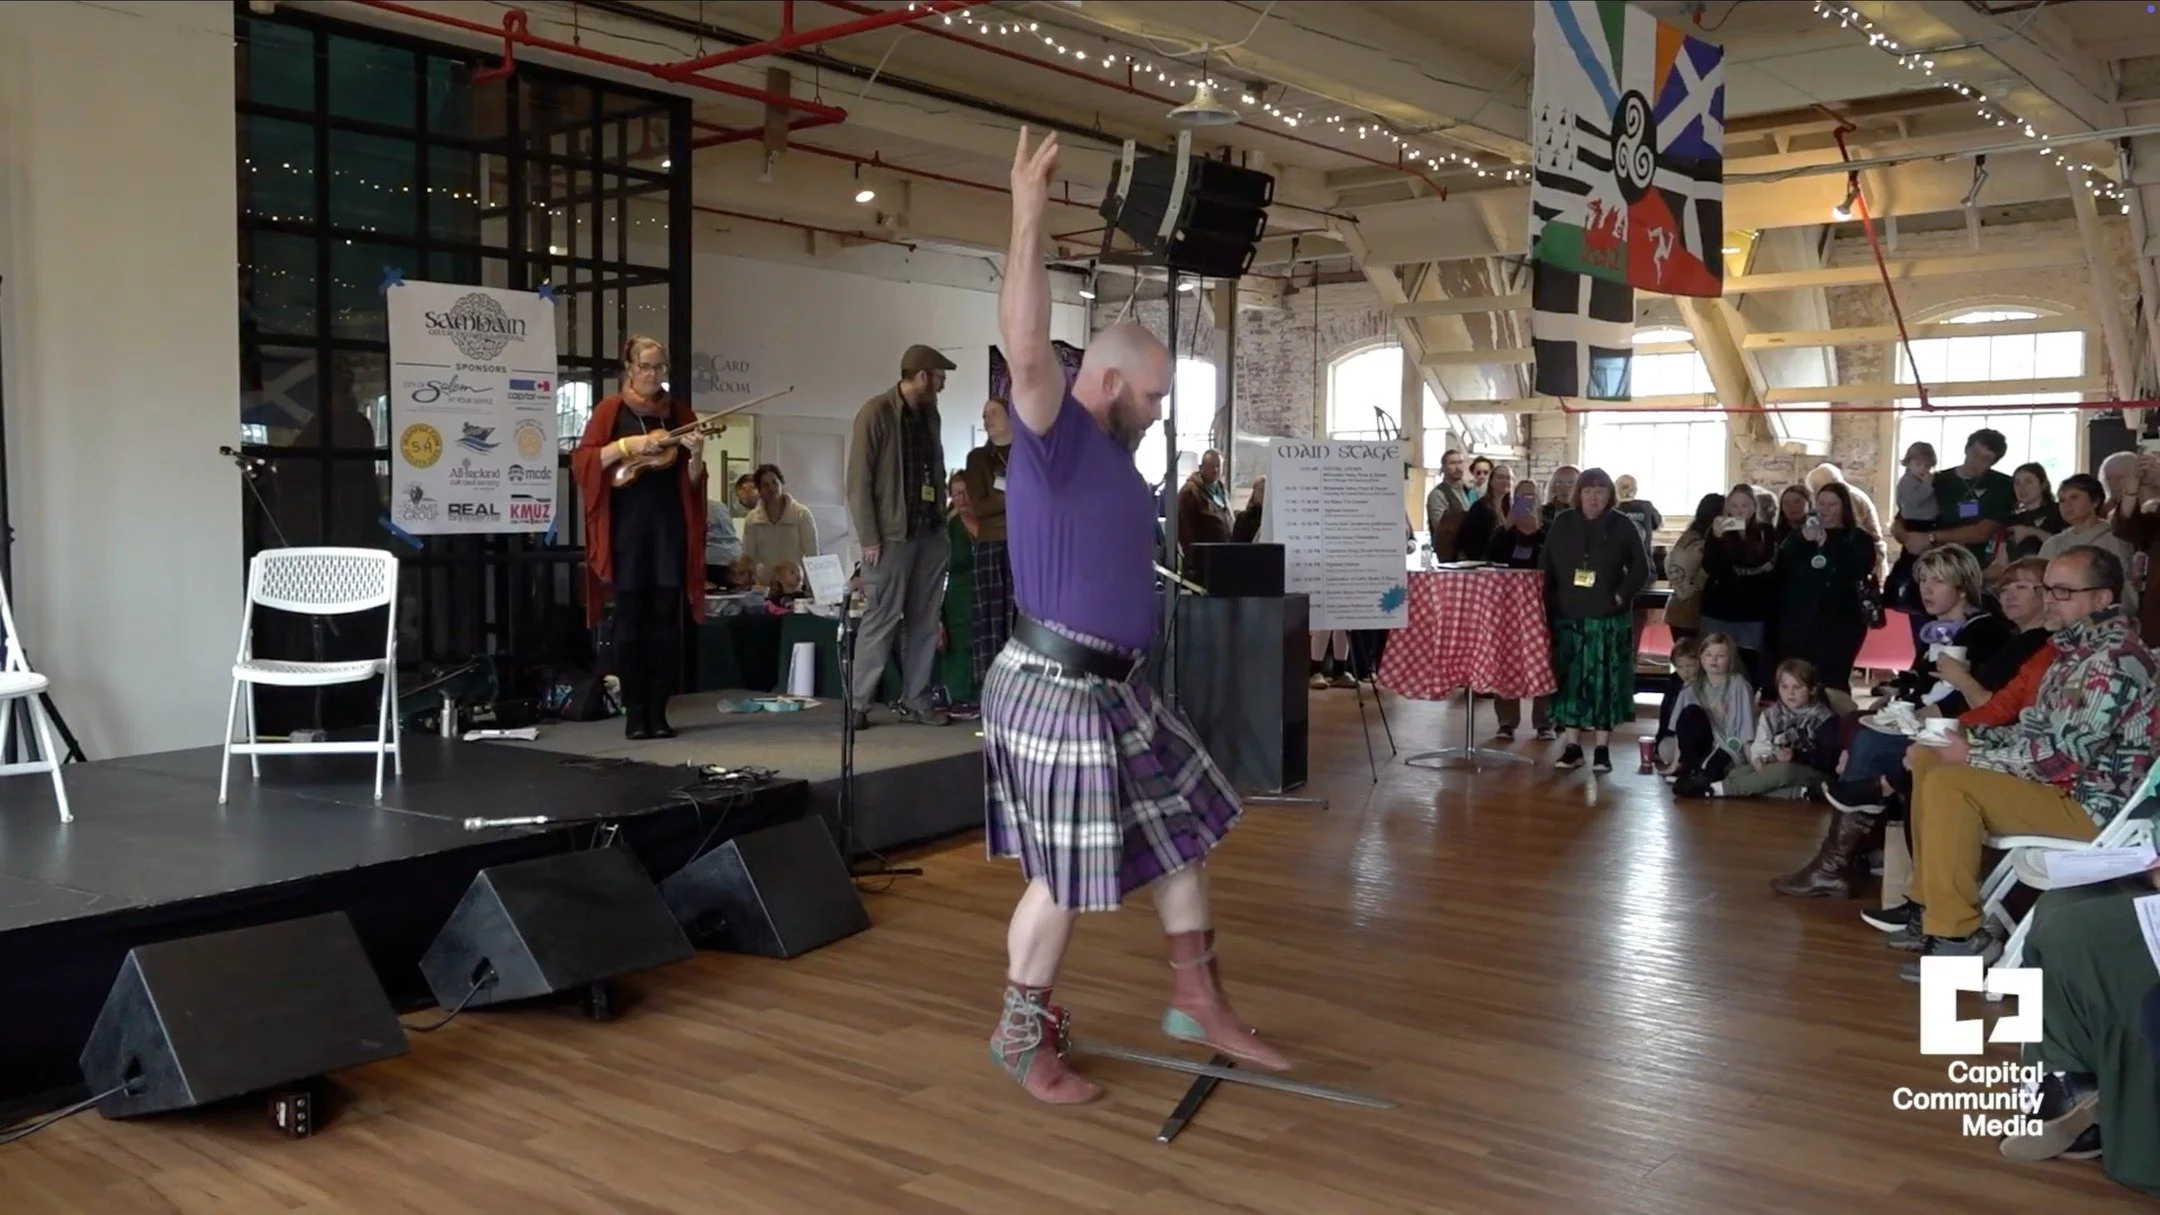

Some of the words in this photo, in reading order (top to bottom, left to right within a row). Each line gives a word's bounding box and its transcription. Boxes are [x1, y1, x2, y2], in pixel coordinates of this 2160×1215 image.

[455, 363, 508, 374] SPONSORS
[411, 374, 495, 404] Salem
[1277, 444, 1330, 459] MAIN
[1338, 444, 1400, 461] STAGE
[525, 465, 553, 480] mcdc
[448, 503, 500, 516] REAL
[510, 504, 552, 519] KMUZ
